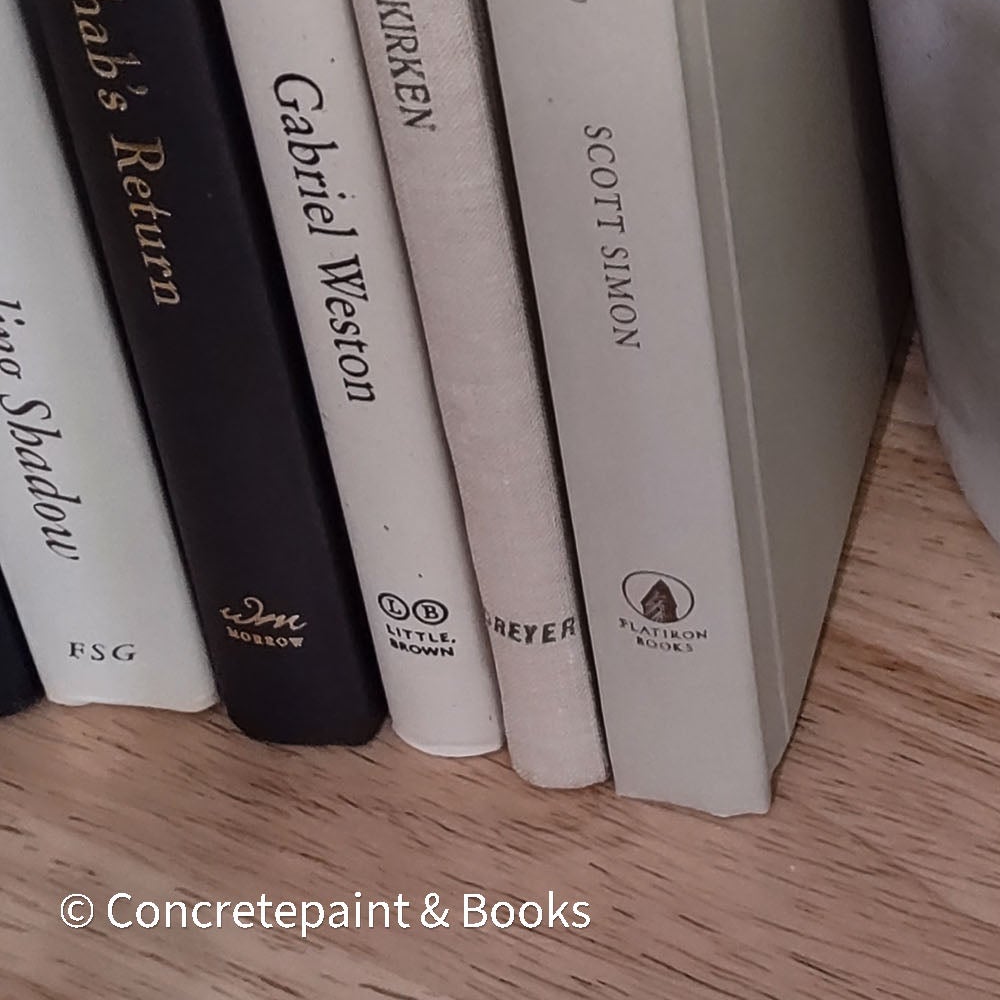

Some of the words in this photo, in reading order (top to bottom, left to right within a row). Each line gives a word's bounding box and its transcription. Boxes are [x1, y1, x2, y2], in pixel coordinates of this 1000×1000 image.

[110, 133, 181, 309] Return
[584, 125, 626, 233] SCOTT
[273, 73, 359, 238] Gabriel
[317, 254, 376, 402] Weston
[601, 246, 640, 349] SIMON
[0, 394, 82, 560] Shadow
[226, 626, 304, 647] MORROW
[389, 638, 455, 656] BROWN
[619, 617, 707, 639] FLATIRON
[636, 636, 693, 652] BOOKS
